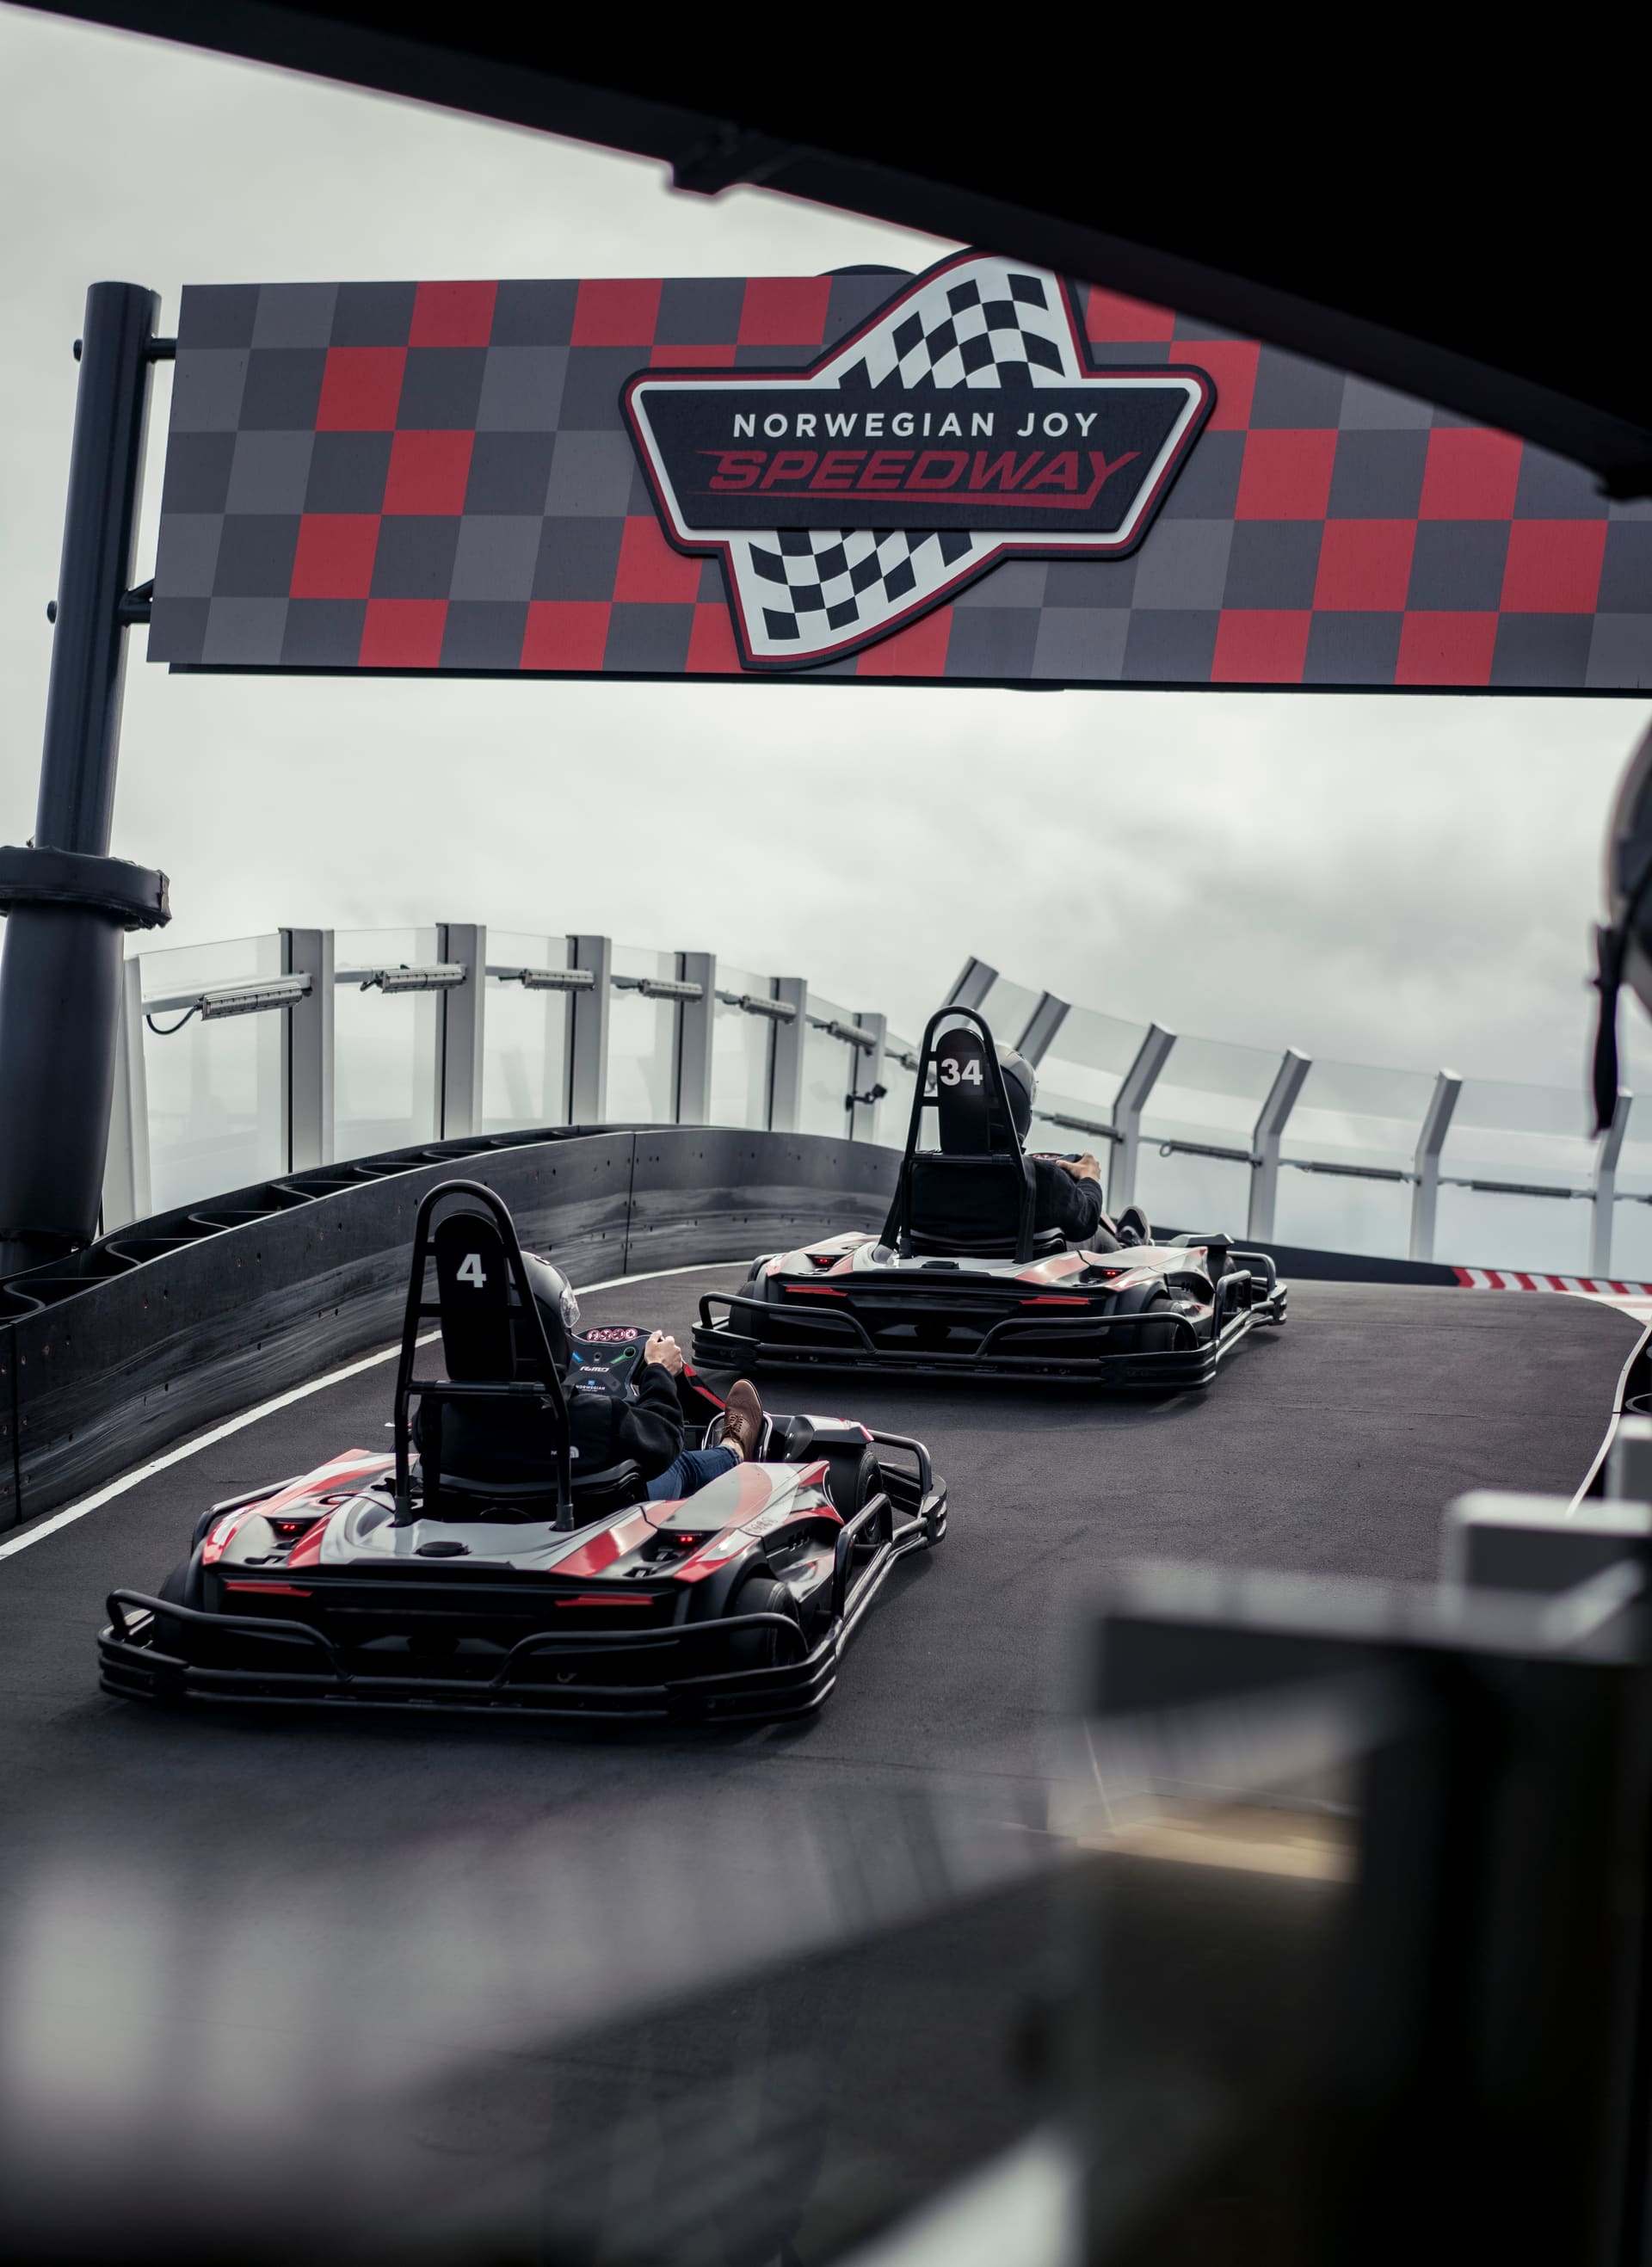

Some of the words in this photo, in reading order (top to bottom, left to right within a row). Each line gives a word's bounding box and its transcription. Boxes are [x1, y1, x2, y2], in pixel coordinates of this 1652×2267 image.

[733, 412, 995, 437] NORWEGIAN
[1017, 412, 1099, 437] JOY
[692, 450, 1142, 509] SPEEDWAY
[940, 1057, 983, 1086] 34
[456, 1254, 487, 1288] 4
